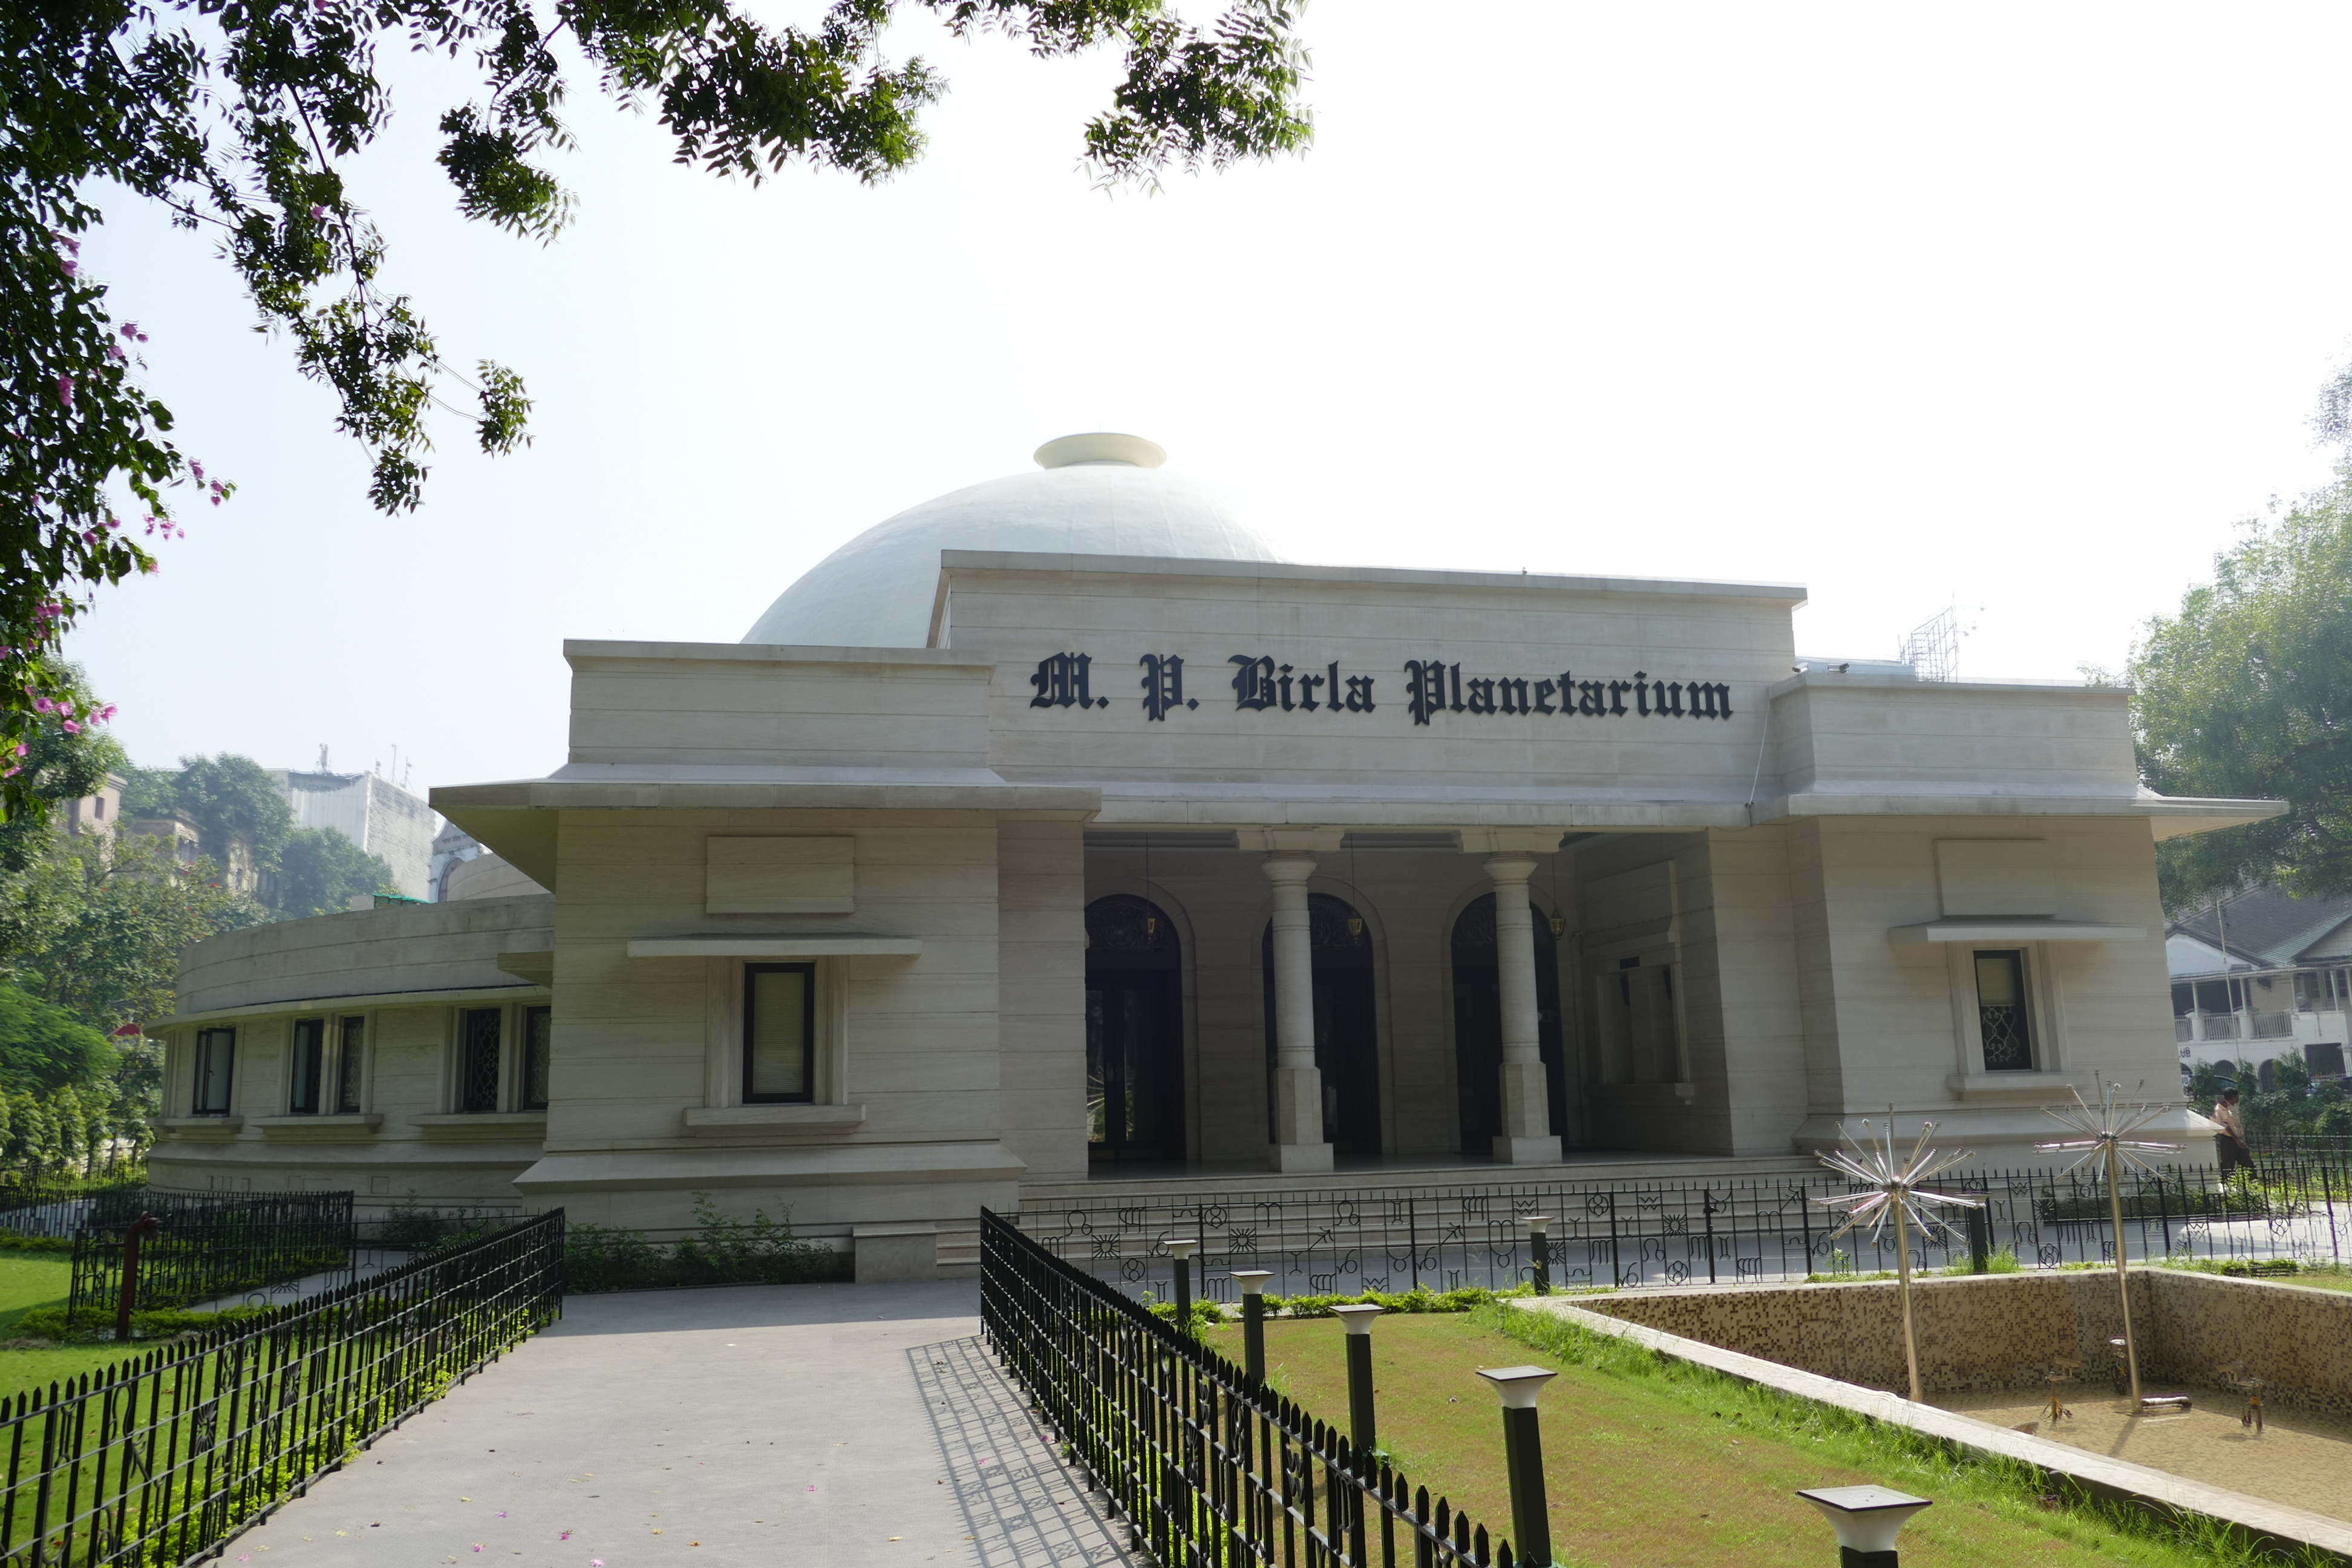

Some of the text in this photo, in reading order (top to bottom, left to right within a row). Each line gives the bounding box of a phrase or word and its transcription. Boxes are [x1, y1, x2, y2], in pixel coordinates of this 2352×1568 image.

[1030, 652, 1734, 725] M. P. Birla Planetarium
